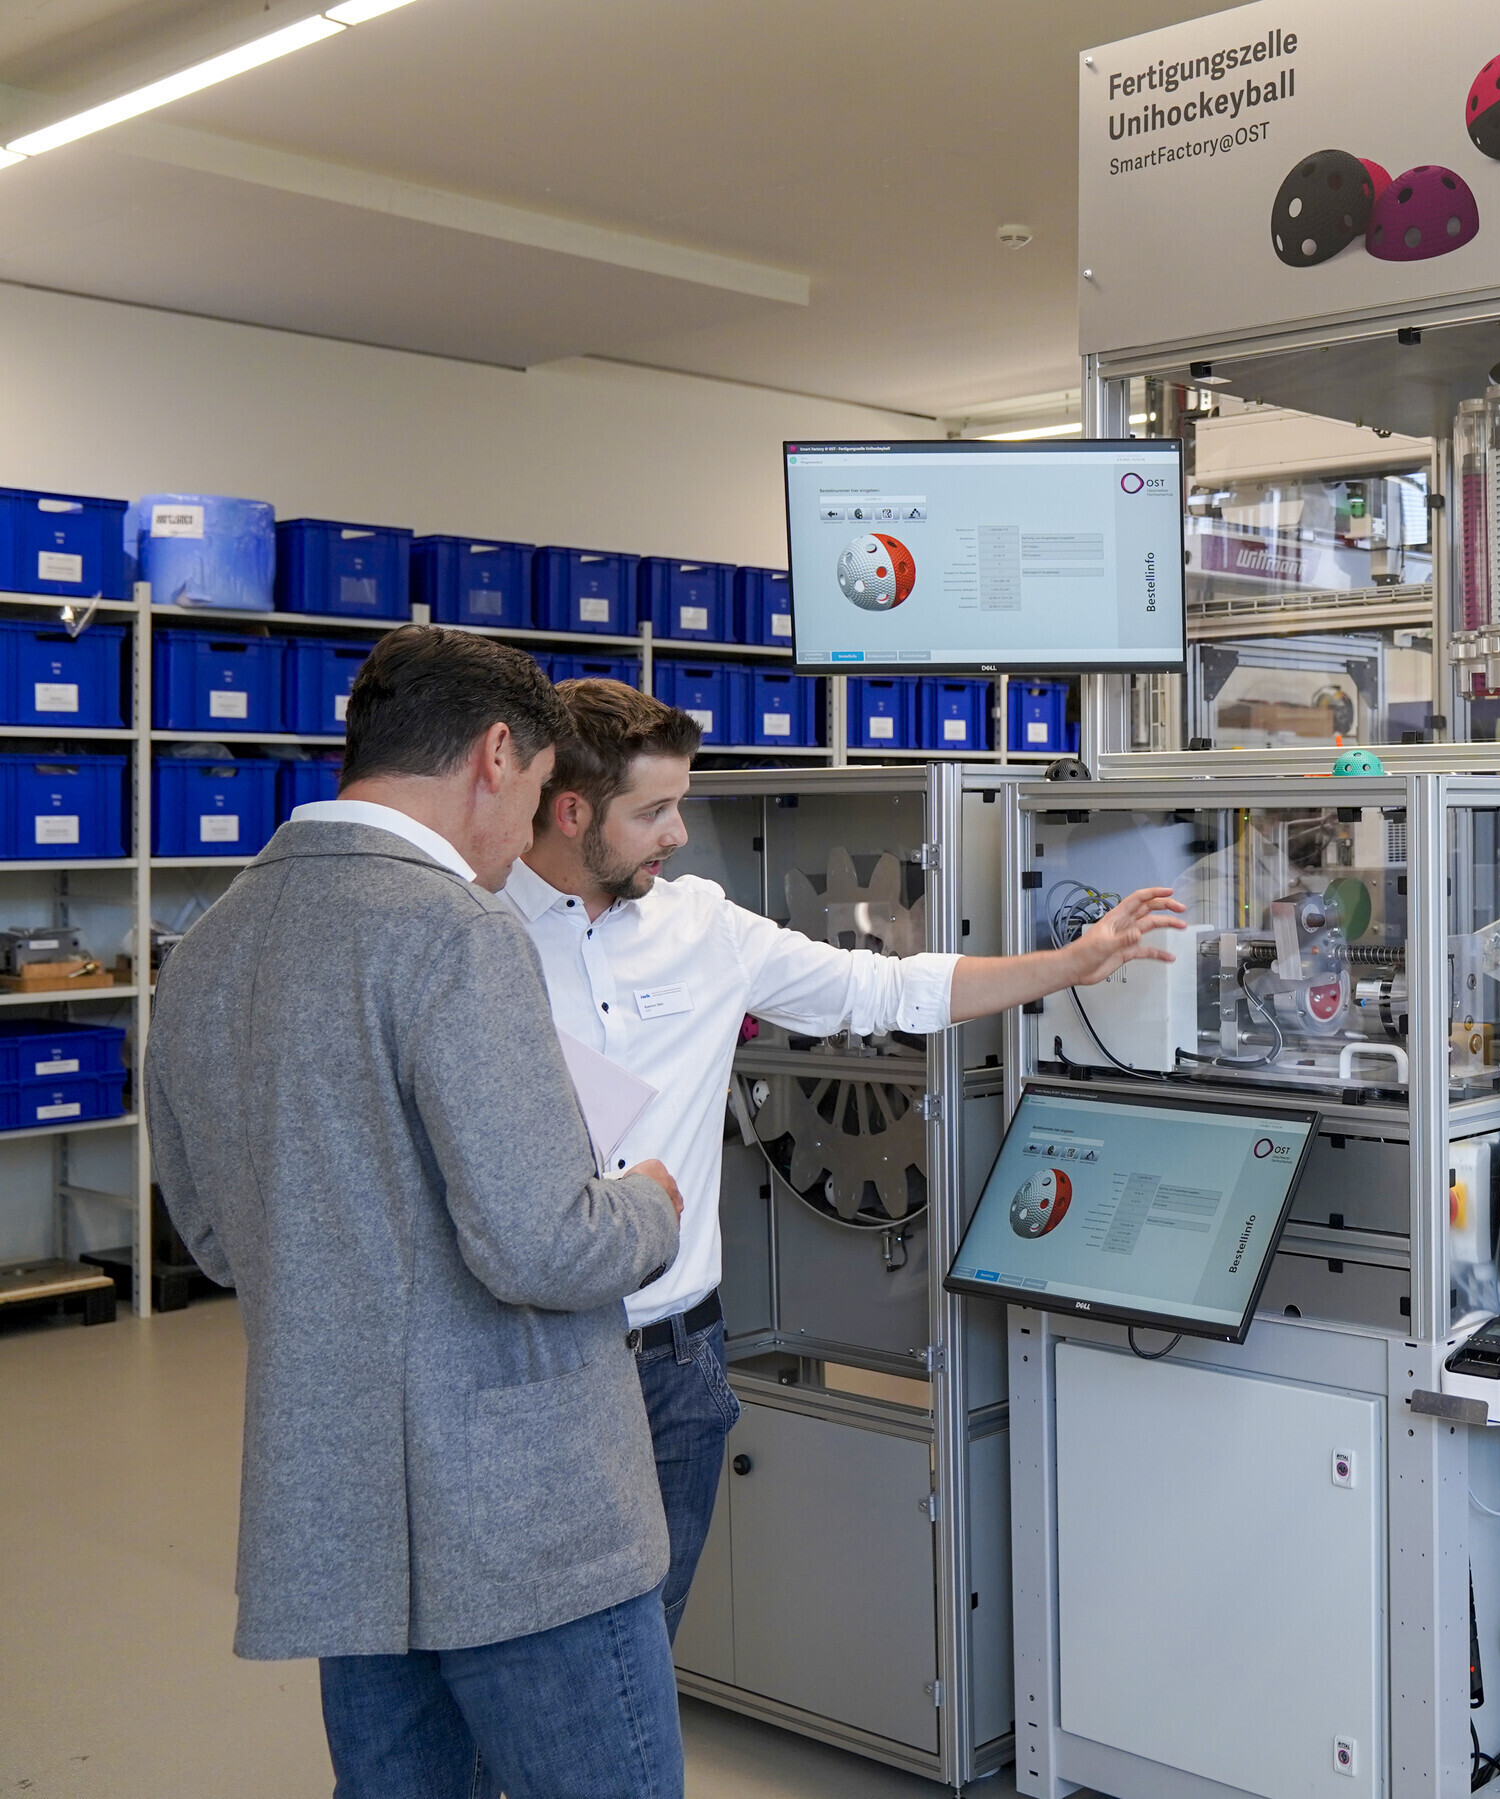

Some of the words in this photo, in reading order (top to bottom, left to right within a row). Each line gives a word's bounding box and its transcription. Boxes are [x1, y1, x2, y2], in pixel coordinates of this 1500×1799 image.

[1109, 28, 1298, 100] Fertigungszelle
[1109, 68, 1295, 140] Unihockeyball
[1109, 121, 1270, 175] SmartFactory@OST
[1146, 479, 1165, 487] OST
[1145, 552, 1156, 612] Bestellinfo
[1274, 1146, 1291, 1155] OST
[1229, 1214, 1256, 1273] Bestellinfo
[1075, 1301, 1091, 1310] DELL
